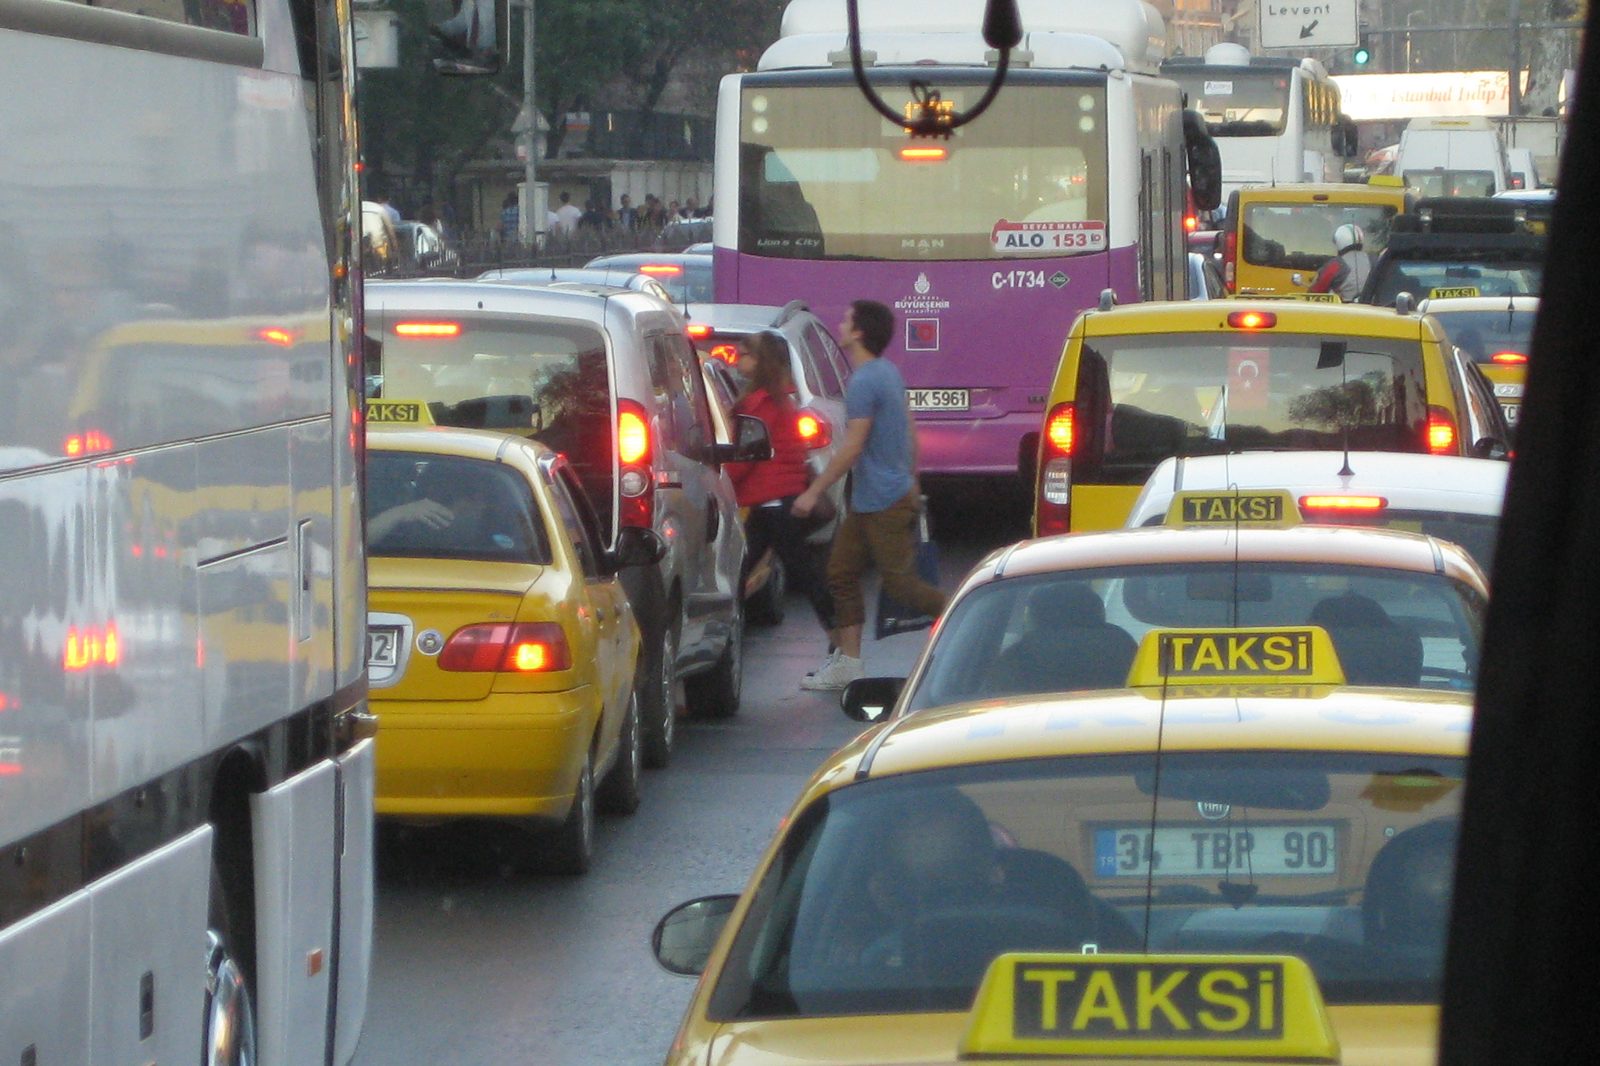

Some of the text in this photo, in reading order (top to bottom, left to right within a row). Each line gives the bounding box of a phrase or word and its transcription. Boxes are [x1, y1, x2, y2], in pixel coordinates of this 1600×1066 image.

[1269, 4, 1331, 15] Levent
[1057, 222, 1084, 230] MASA
[795, 238, 820, 247] City
[901, 239, 945, 248] MAN
[1005, 233, 1044, 248] ALO
[1052, 233, 1087, 248] 153
[991, 270, 1045, 289] C-1734
[907, 391, 966, 406] HK 5961
[366, 404, 415, 420] AKSi
[367, 634, 389, 661] 2
[1172, 636, 1308, 671] TAKSi
[1191, 831, 1255, 869] TBP
[1283, 831, 1328, 869] 90
[1023, 970, 1276, 1031] TAKSi
